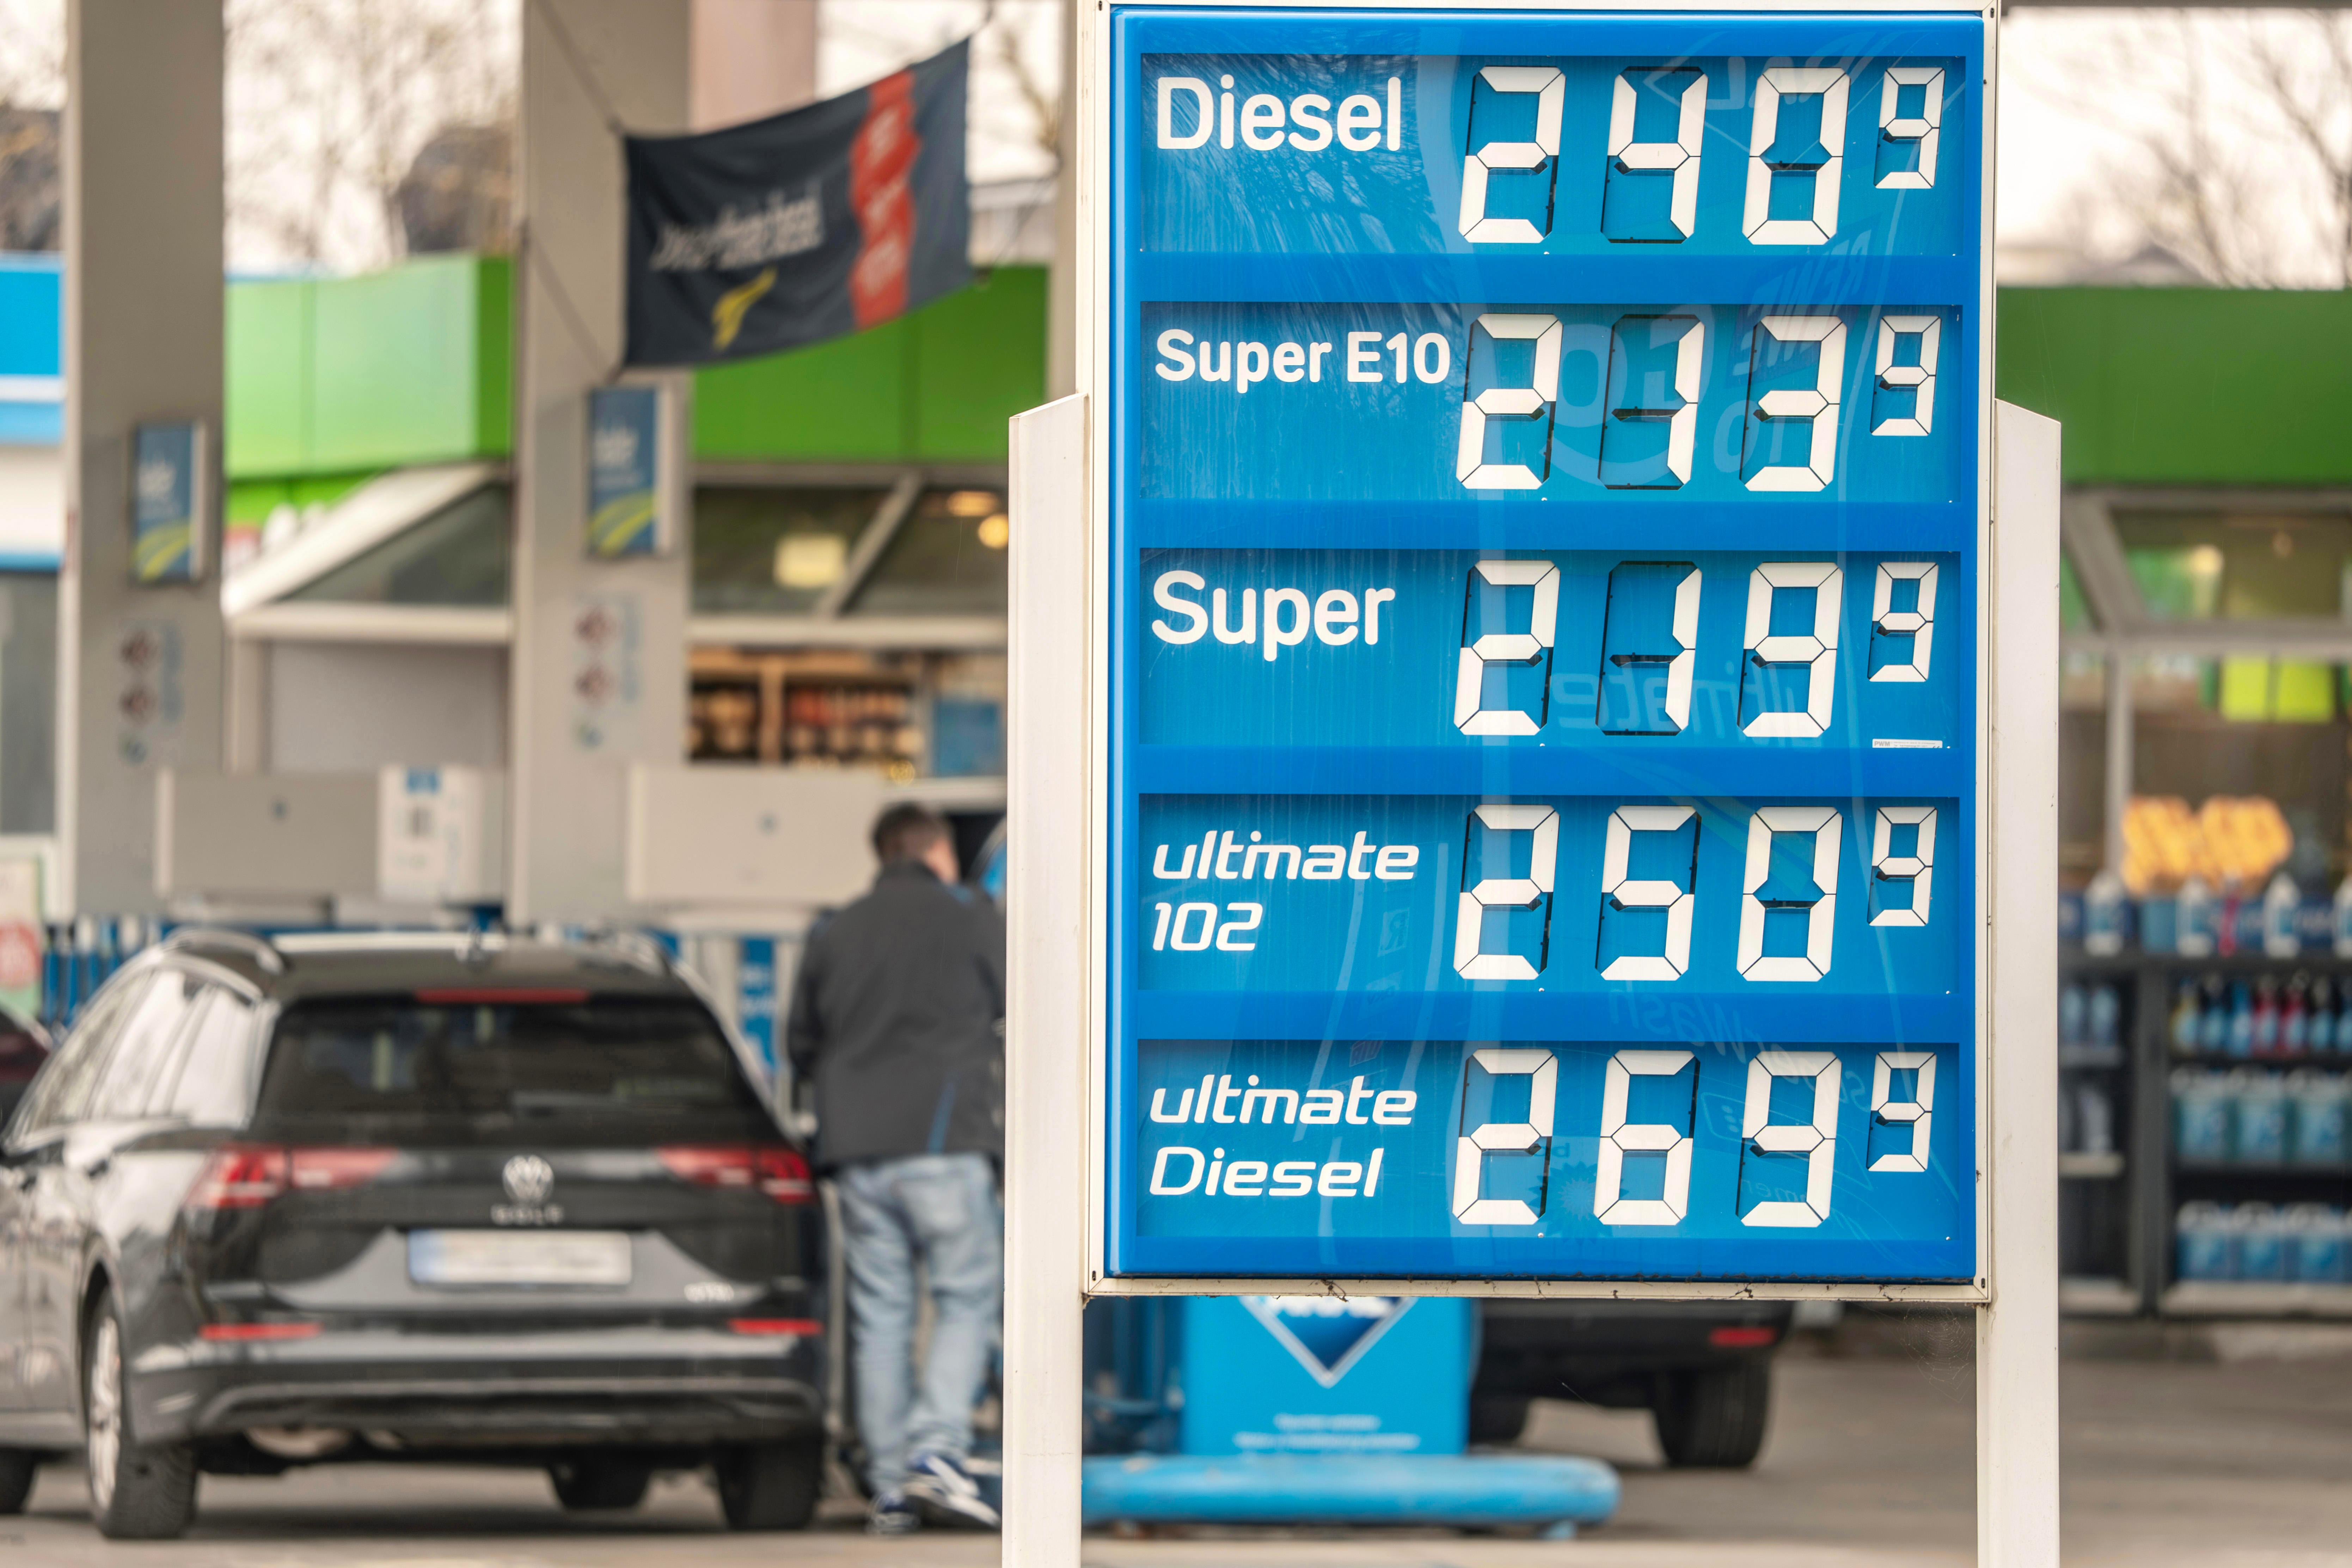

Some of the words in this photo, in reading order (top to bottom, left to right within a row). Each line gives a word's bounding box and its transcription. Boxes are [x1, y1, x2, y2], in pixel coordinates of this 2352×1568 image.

[1157, 74, 1401, 152] Diesel
[1156, 329, 1332, 393] Super
[1347, 331, 1450, 384] E10
[1152, 570, 1396, 661] Super
[1153, 831, 1419, 880] ultimate
[1153, 902, 1263, 951] 102
[1150, 1074, 1417, 1125] ultimate
[1149, 1146, 1384, 1197] Diesel
